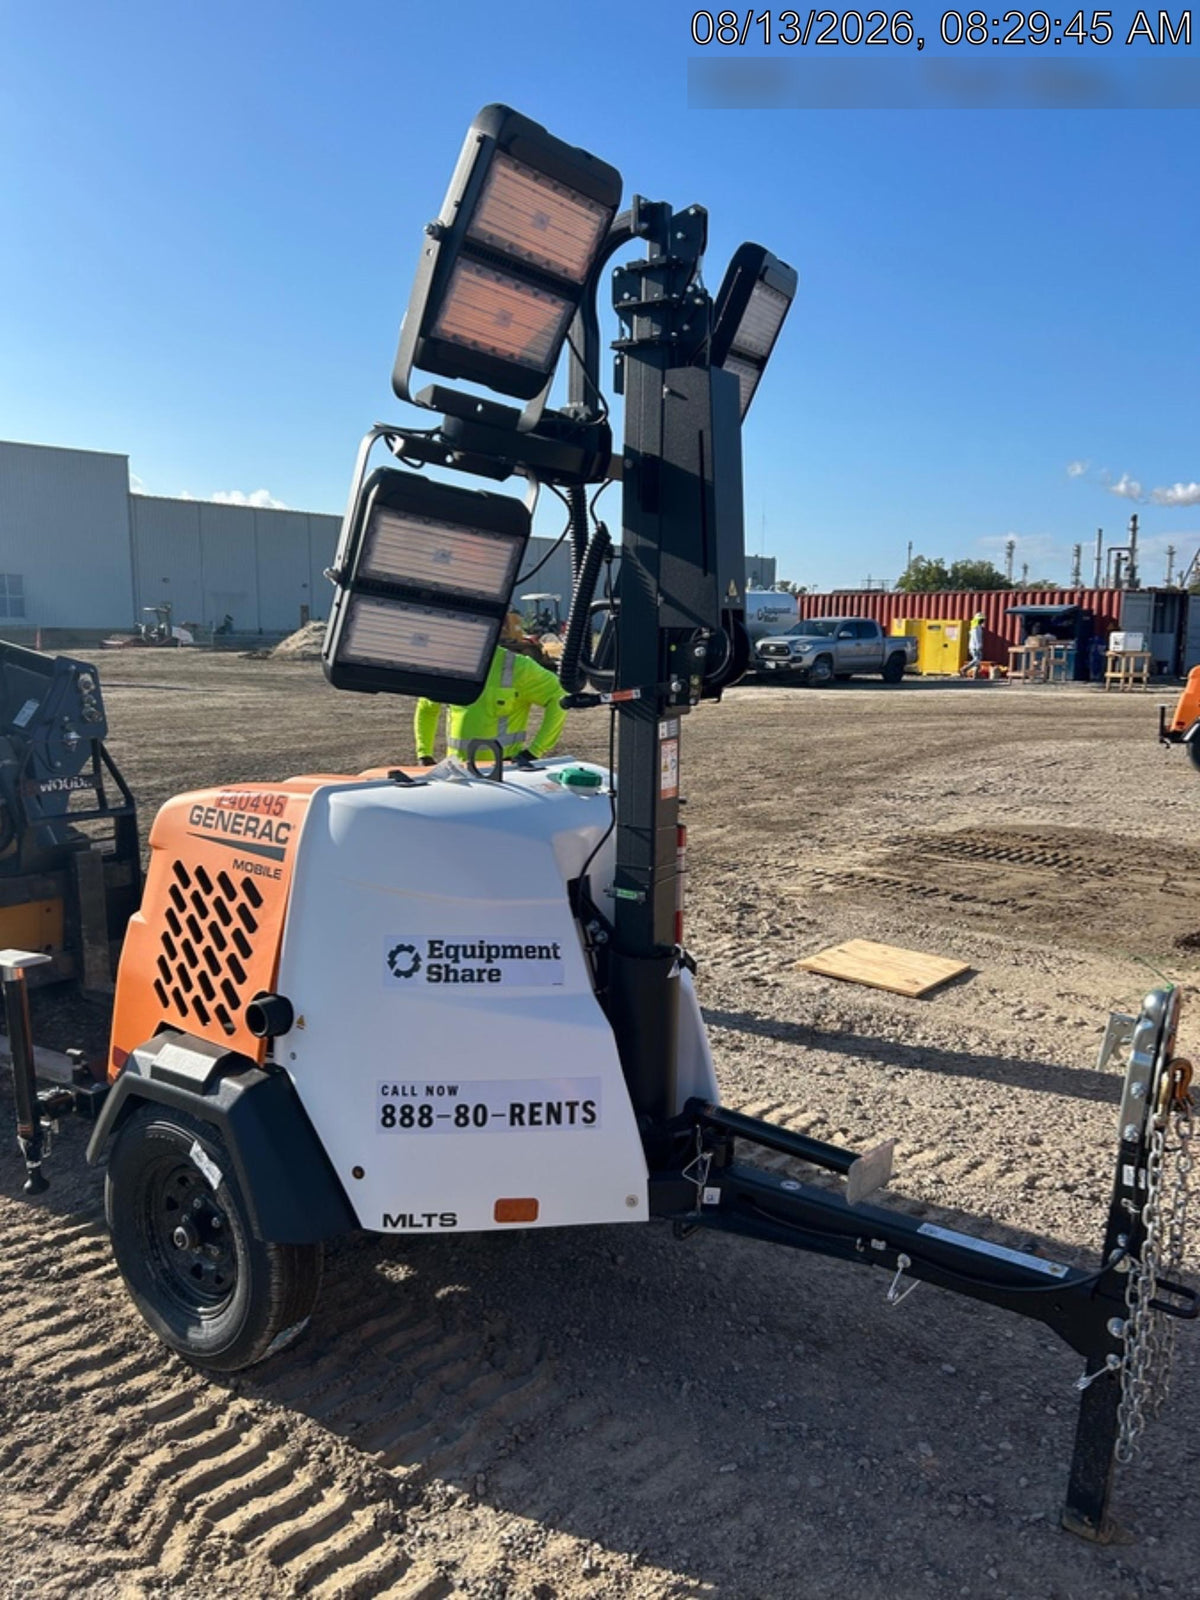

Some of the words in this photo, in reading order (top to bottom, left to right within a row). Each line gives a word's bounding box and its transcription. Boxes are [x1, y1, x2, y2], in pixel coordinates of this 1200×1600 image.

[189, 804, 292, 845] GENERAC
[232, 858, 283, 881] MOBILE
[427, 940, 562, 963] Equipment
[426, 964, 502, 983] Share
[381, 1085, 418, 1097] CALL
[425, 1085, 459, 1097] NOW
[381, 1100, 597, 1128] 888-80-RENTS
[383, 1212, 457, 1228] MLTS
